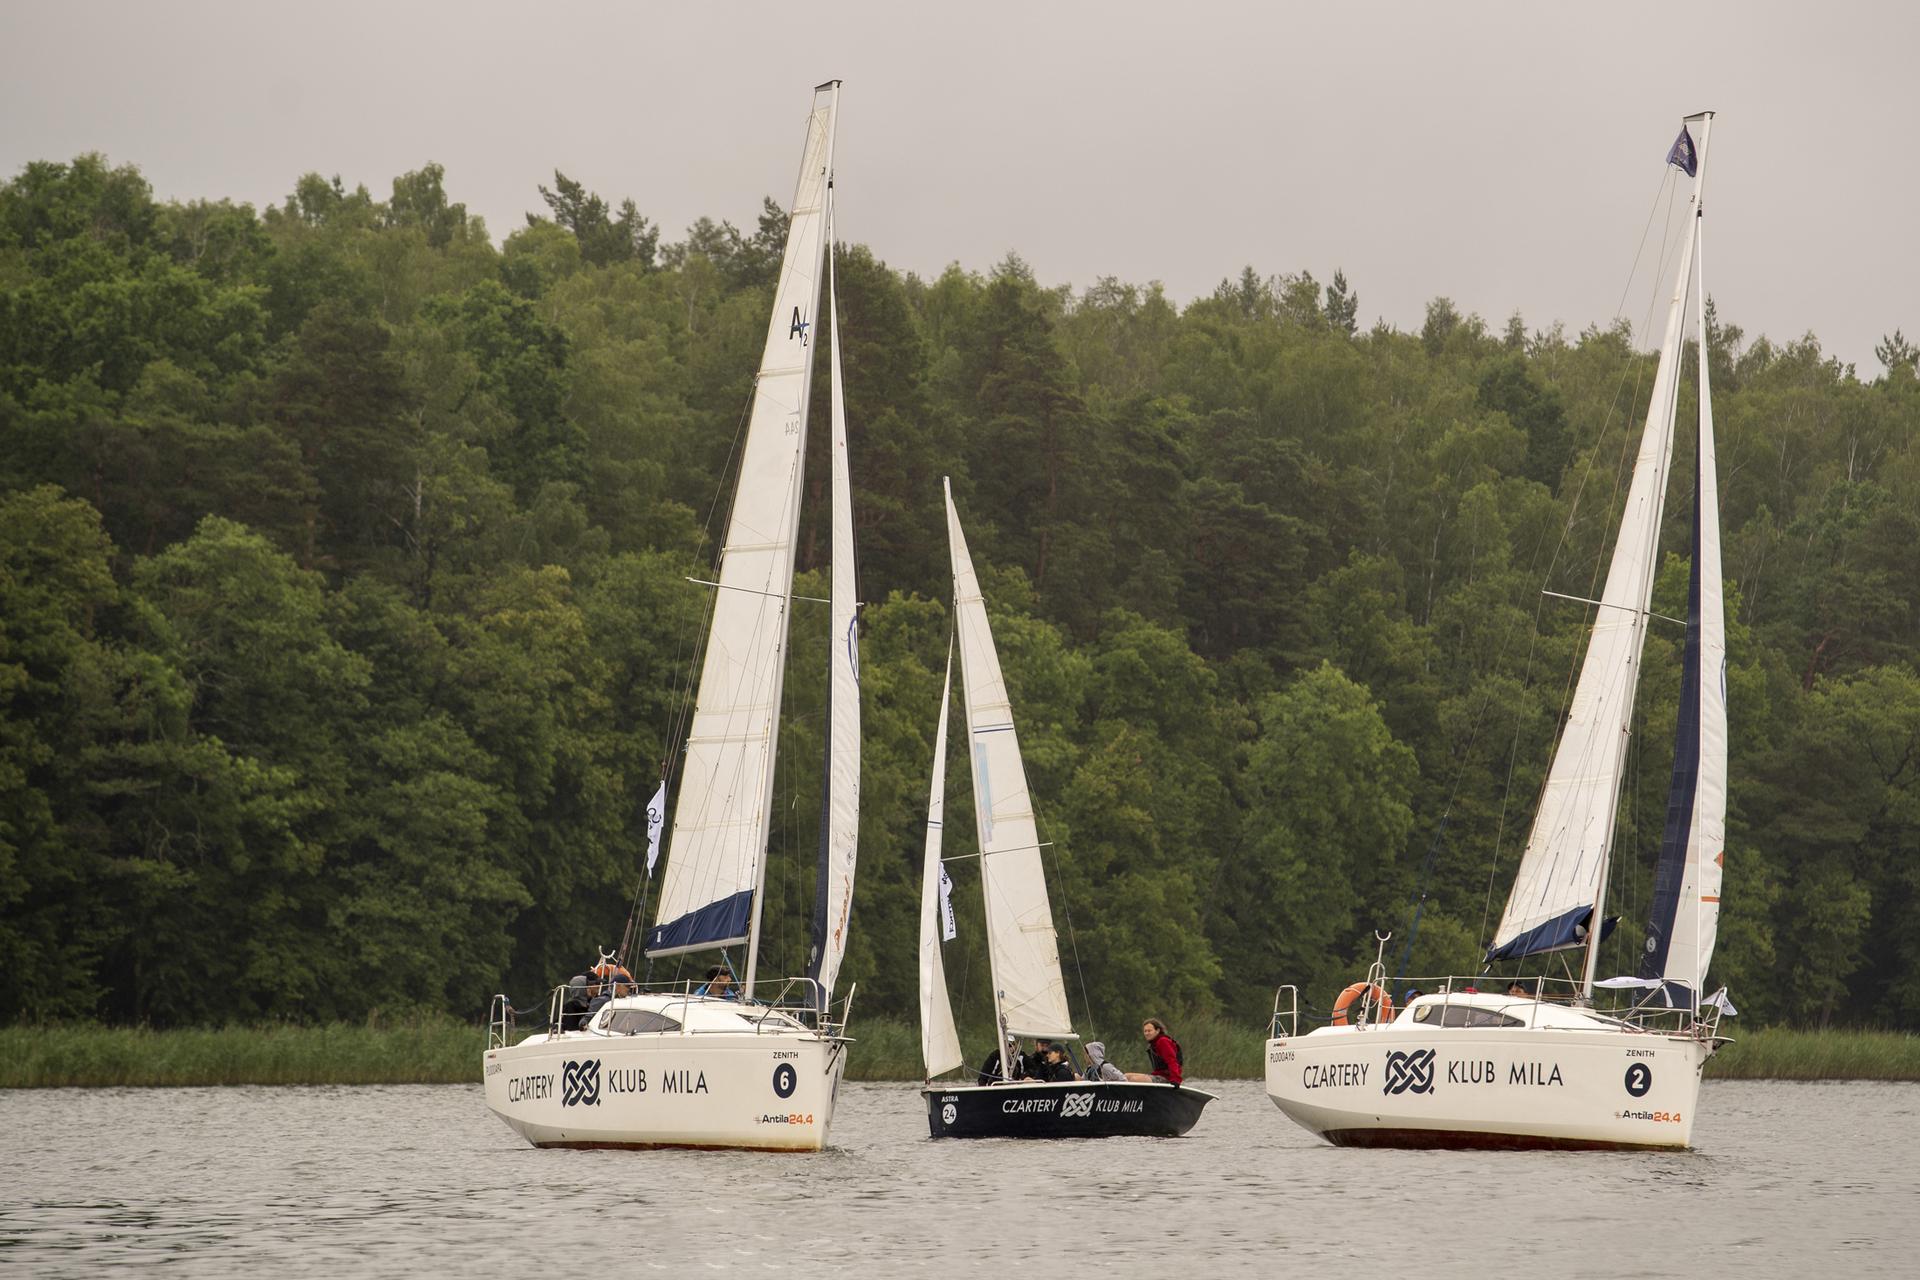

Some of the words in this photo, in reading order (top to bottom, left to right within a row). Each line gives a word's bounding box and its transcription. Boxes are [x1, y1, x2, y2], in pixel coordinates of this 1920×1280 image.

[1626, 1049, 1655, 1057] ZENITH
[780, 1071, 789, 1091] 6
[1303, 1063, 1370, 1089] CZARTERY
[1448, 1061, 1496, 1083] KLUB
[1509, 1062, 1564, 1086] MILA
[1631, 1068, 1644, 1089] 2
[508, 1074, 555, 1103] CZARTERY
[609, 1069, 648, 1093] KLUB
[662, 1070, 709, 1094] MILA
[944, 1109, 956, 1120] 24
[1002, 1099, 1058, 1113] CZARTERY
[1095, 1099, 1120, 1113] KLUB
[1121, 1100, 1144, 1113] MILA
